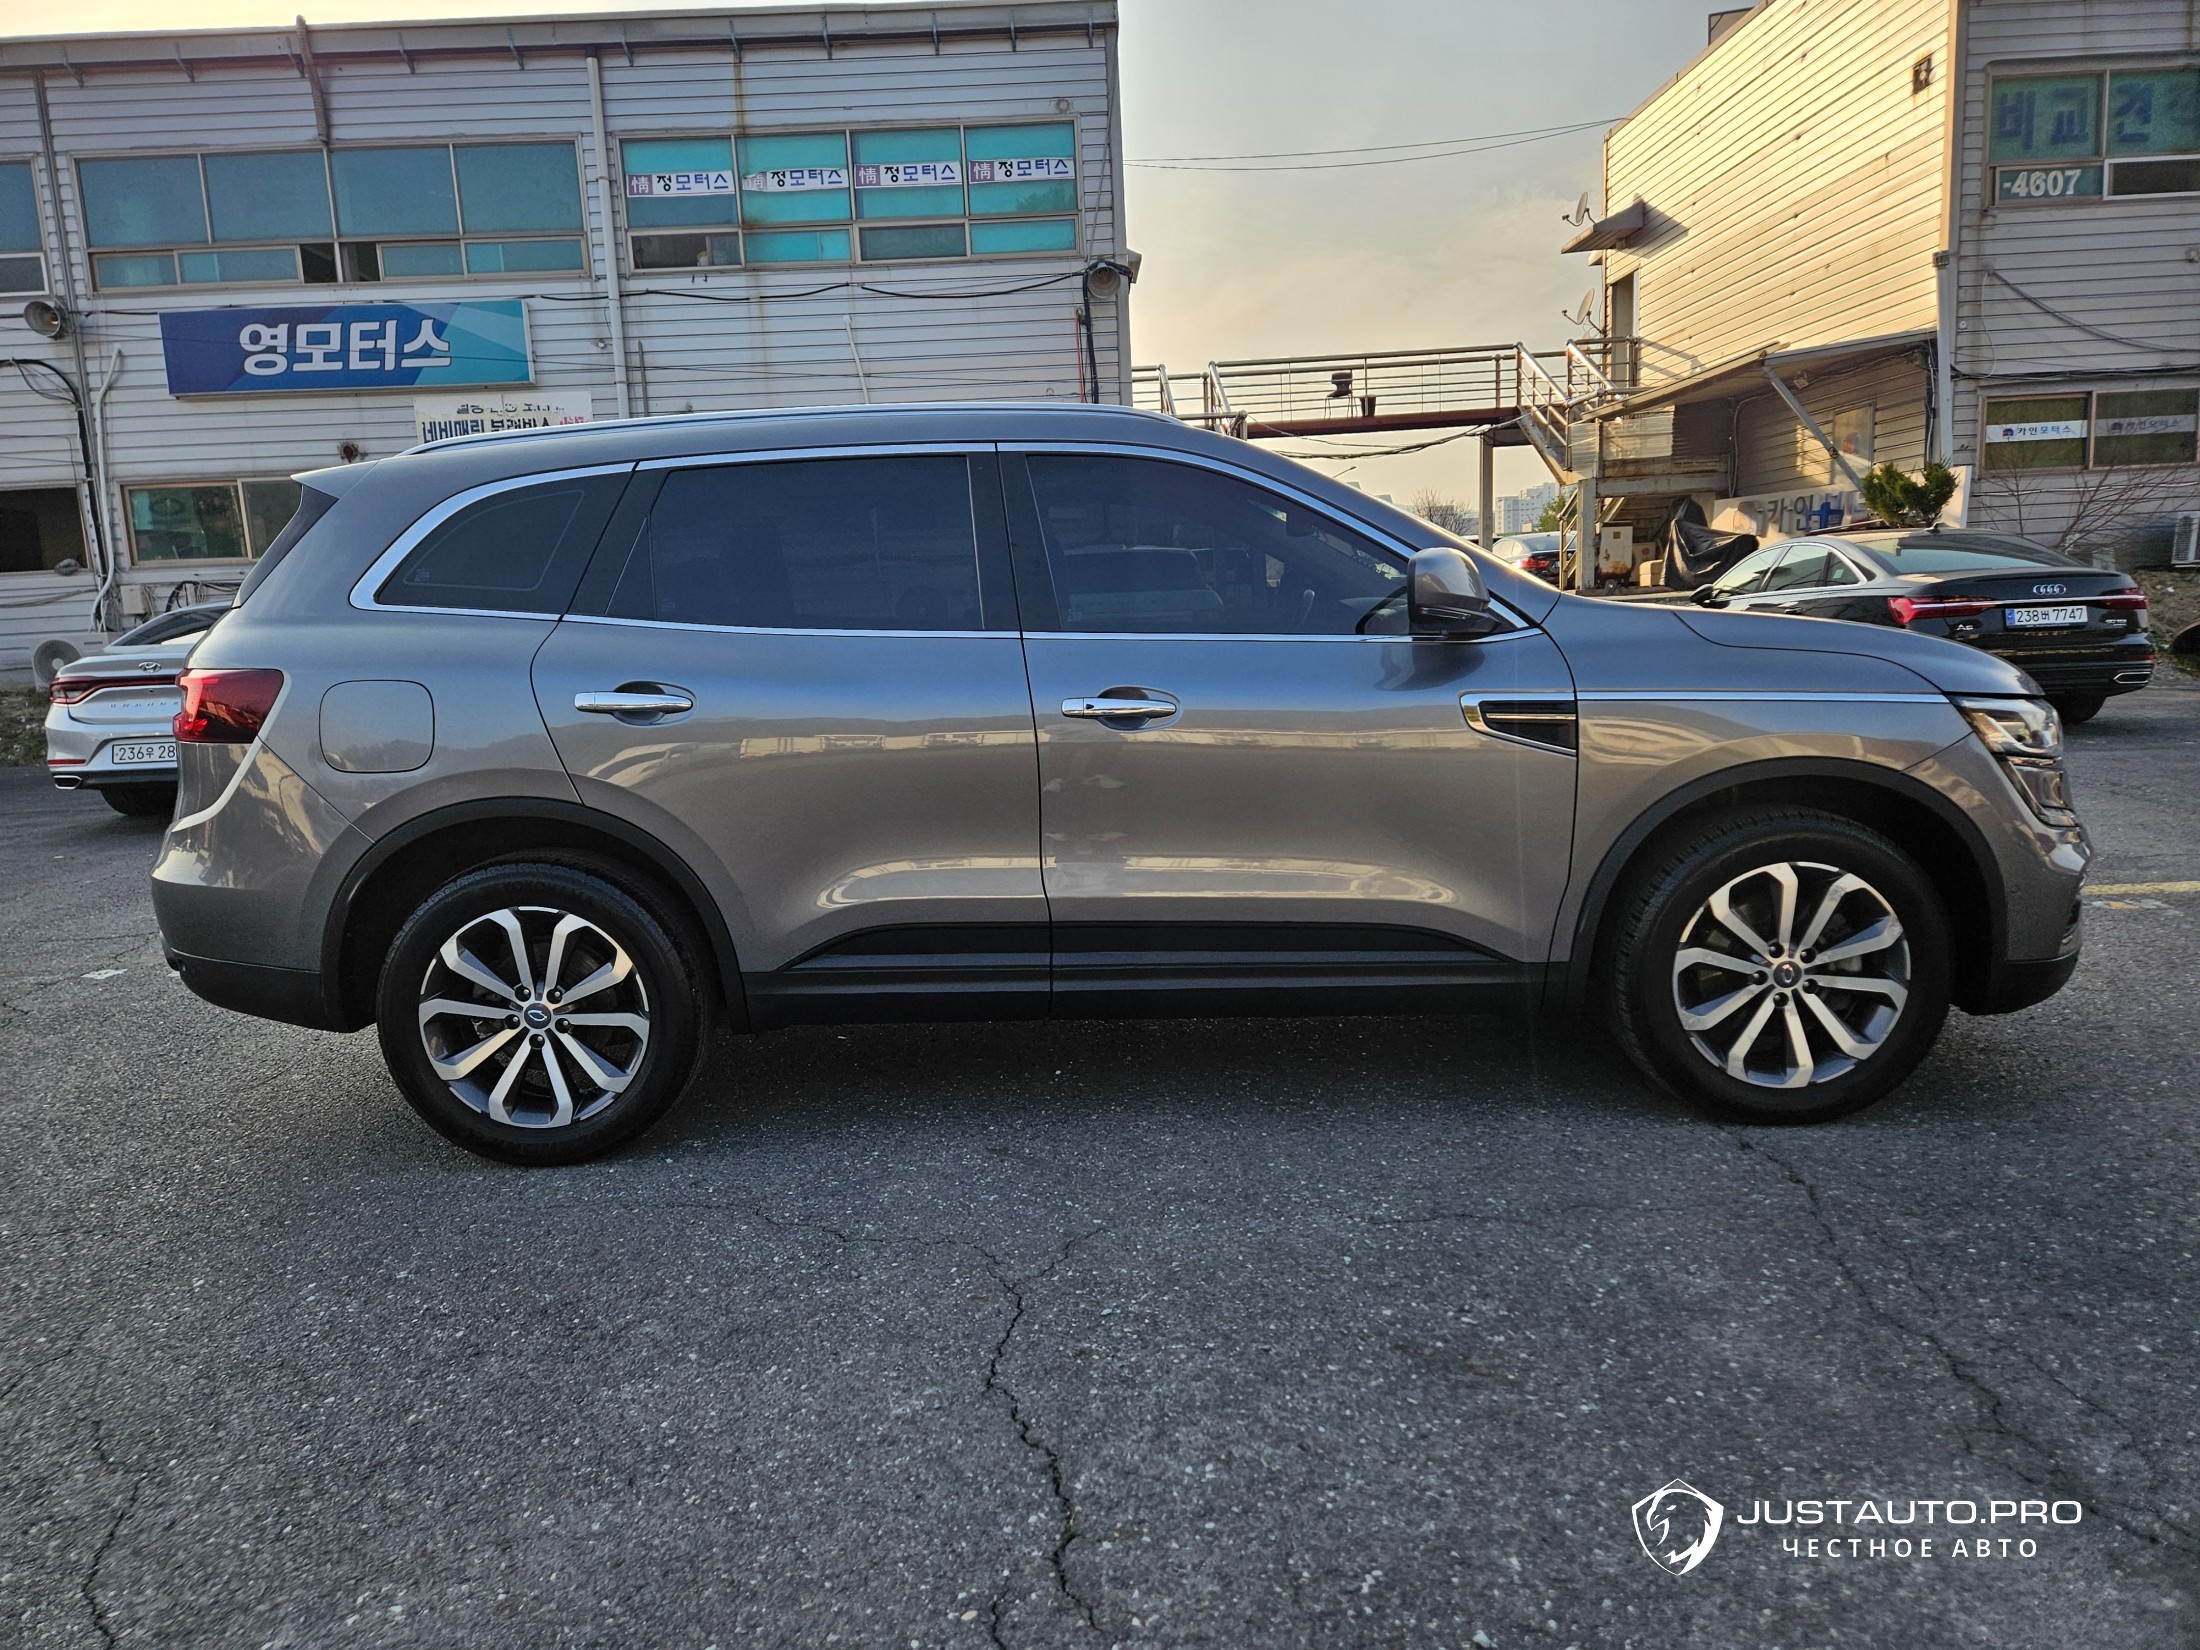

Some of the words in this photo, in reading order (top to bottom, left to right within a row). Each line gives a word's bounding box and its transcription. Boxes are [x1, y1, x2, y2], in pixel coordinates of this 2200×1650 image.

[884, 164, 956, 183] 정모터스
[998, 159, 1069, 178] 정모터스
[656, 173, 729, 192] 정모터스
[770, 170, 843, 188] 정모터스
[239, 318, 452, 377] 영모터스
[2017, 425, 2071, 436] 카인모터스
[2052, 607, 2084, 621] 7747
[158, 745, 176, 759] 28
